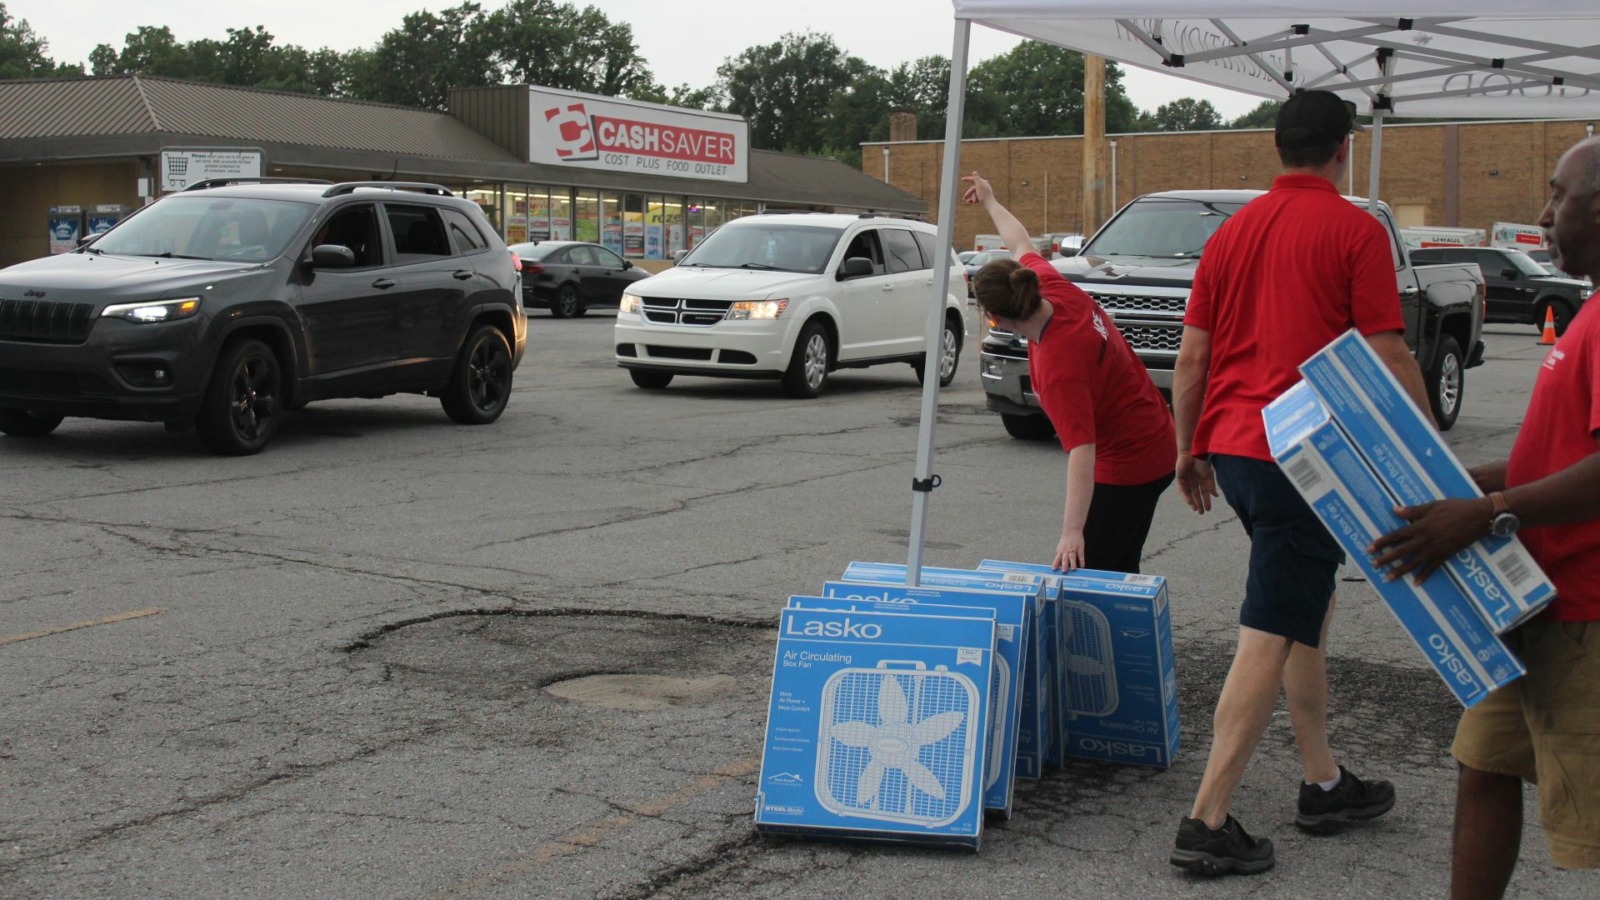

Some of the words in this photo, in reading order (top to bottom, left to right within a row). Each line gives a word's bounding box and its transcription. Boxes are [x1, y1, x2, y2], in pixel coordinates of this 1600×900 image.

[604, 153, 630, 165] COST
[636, 157, 660, 169] PLUS
[666, 160, 690, 172] FOOD
[694, 164, 728, 175] OUTLET
[1326, 502, 1340, 520] Fan
[1339, 517, 1352, 536] Box
[984, 581, 1033, 592] Lasko
[1105, 583, 1151, 594] Lasko
[1456, 549, 1512, 616] Lasko
[786, 614, 882, 639] Lasko
[782, 660, 797, 668] Box
[798, 660, 812, 668] Fan
[783, 650, 798, 660] Air
[800, 650, 852, 664] Circulating
[1429, 633, 1483, 699] Lasko
[1080, 737, 1162, 763] Lasko
